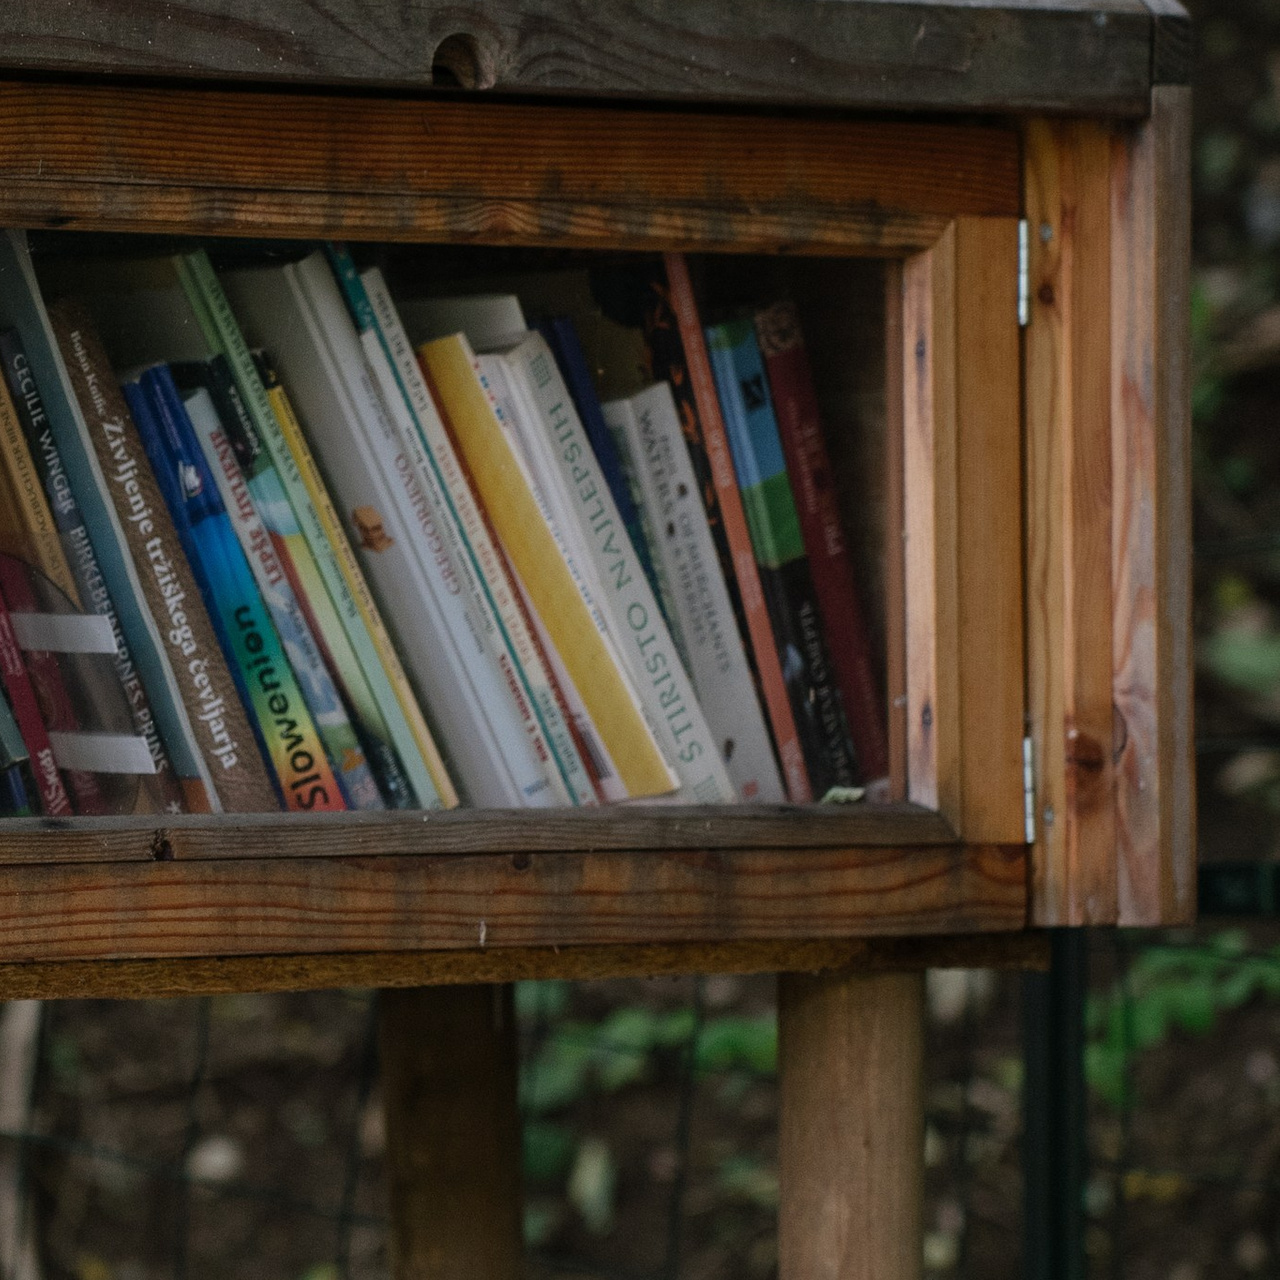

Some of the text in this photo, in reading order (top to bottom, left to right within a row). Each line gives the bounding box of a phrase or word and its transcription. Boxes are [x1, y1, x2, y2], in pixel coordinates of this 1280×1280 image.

[9, 351, 46, 424] CECILIE
[35, 427, 77, 513] WINGER
[99, 413, 240, 770] Življenje tržiškega čevljarja
[232, 604, 331, 813] Slowenien
